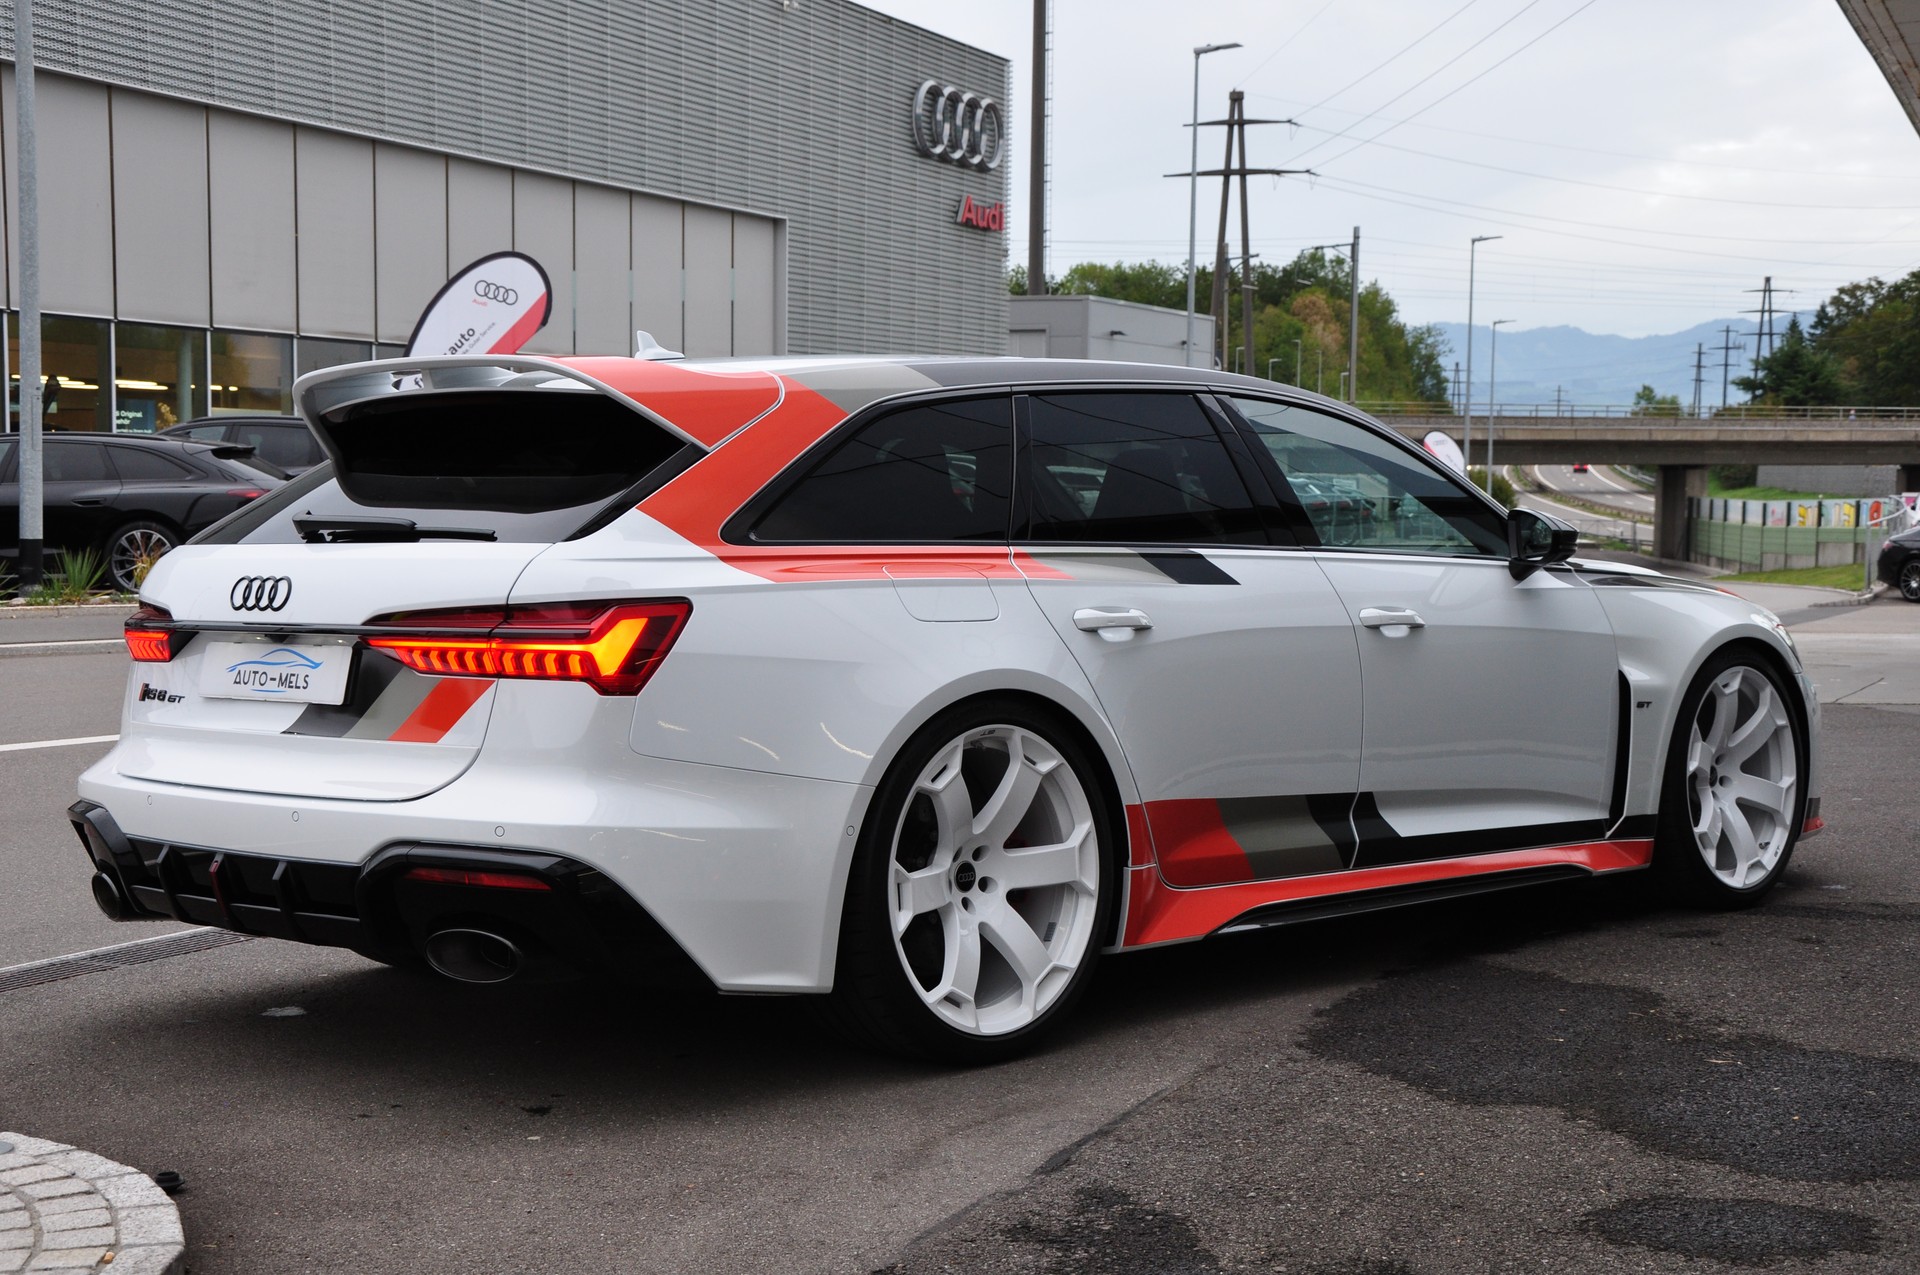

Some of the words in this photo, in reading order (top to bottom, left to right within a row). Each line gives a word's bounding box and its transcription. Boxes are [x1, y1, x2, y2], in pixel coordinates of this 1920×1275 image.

[960, 194, 1006, 233] Audi
[233, 669, 310, 690] AUTO-MELS
[167, 694, 186, 704] GT
[1636, 701, 1653, 709] GT
